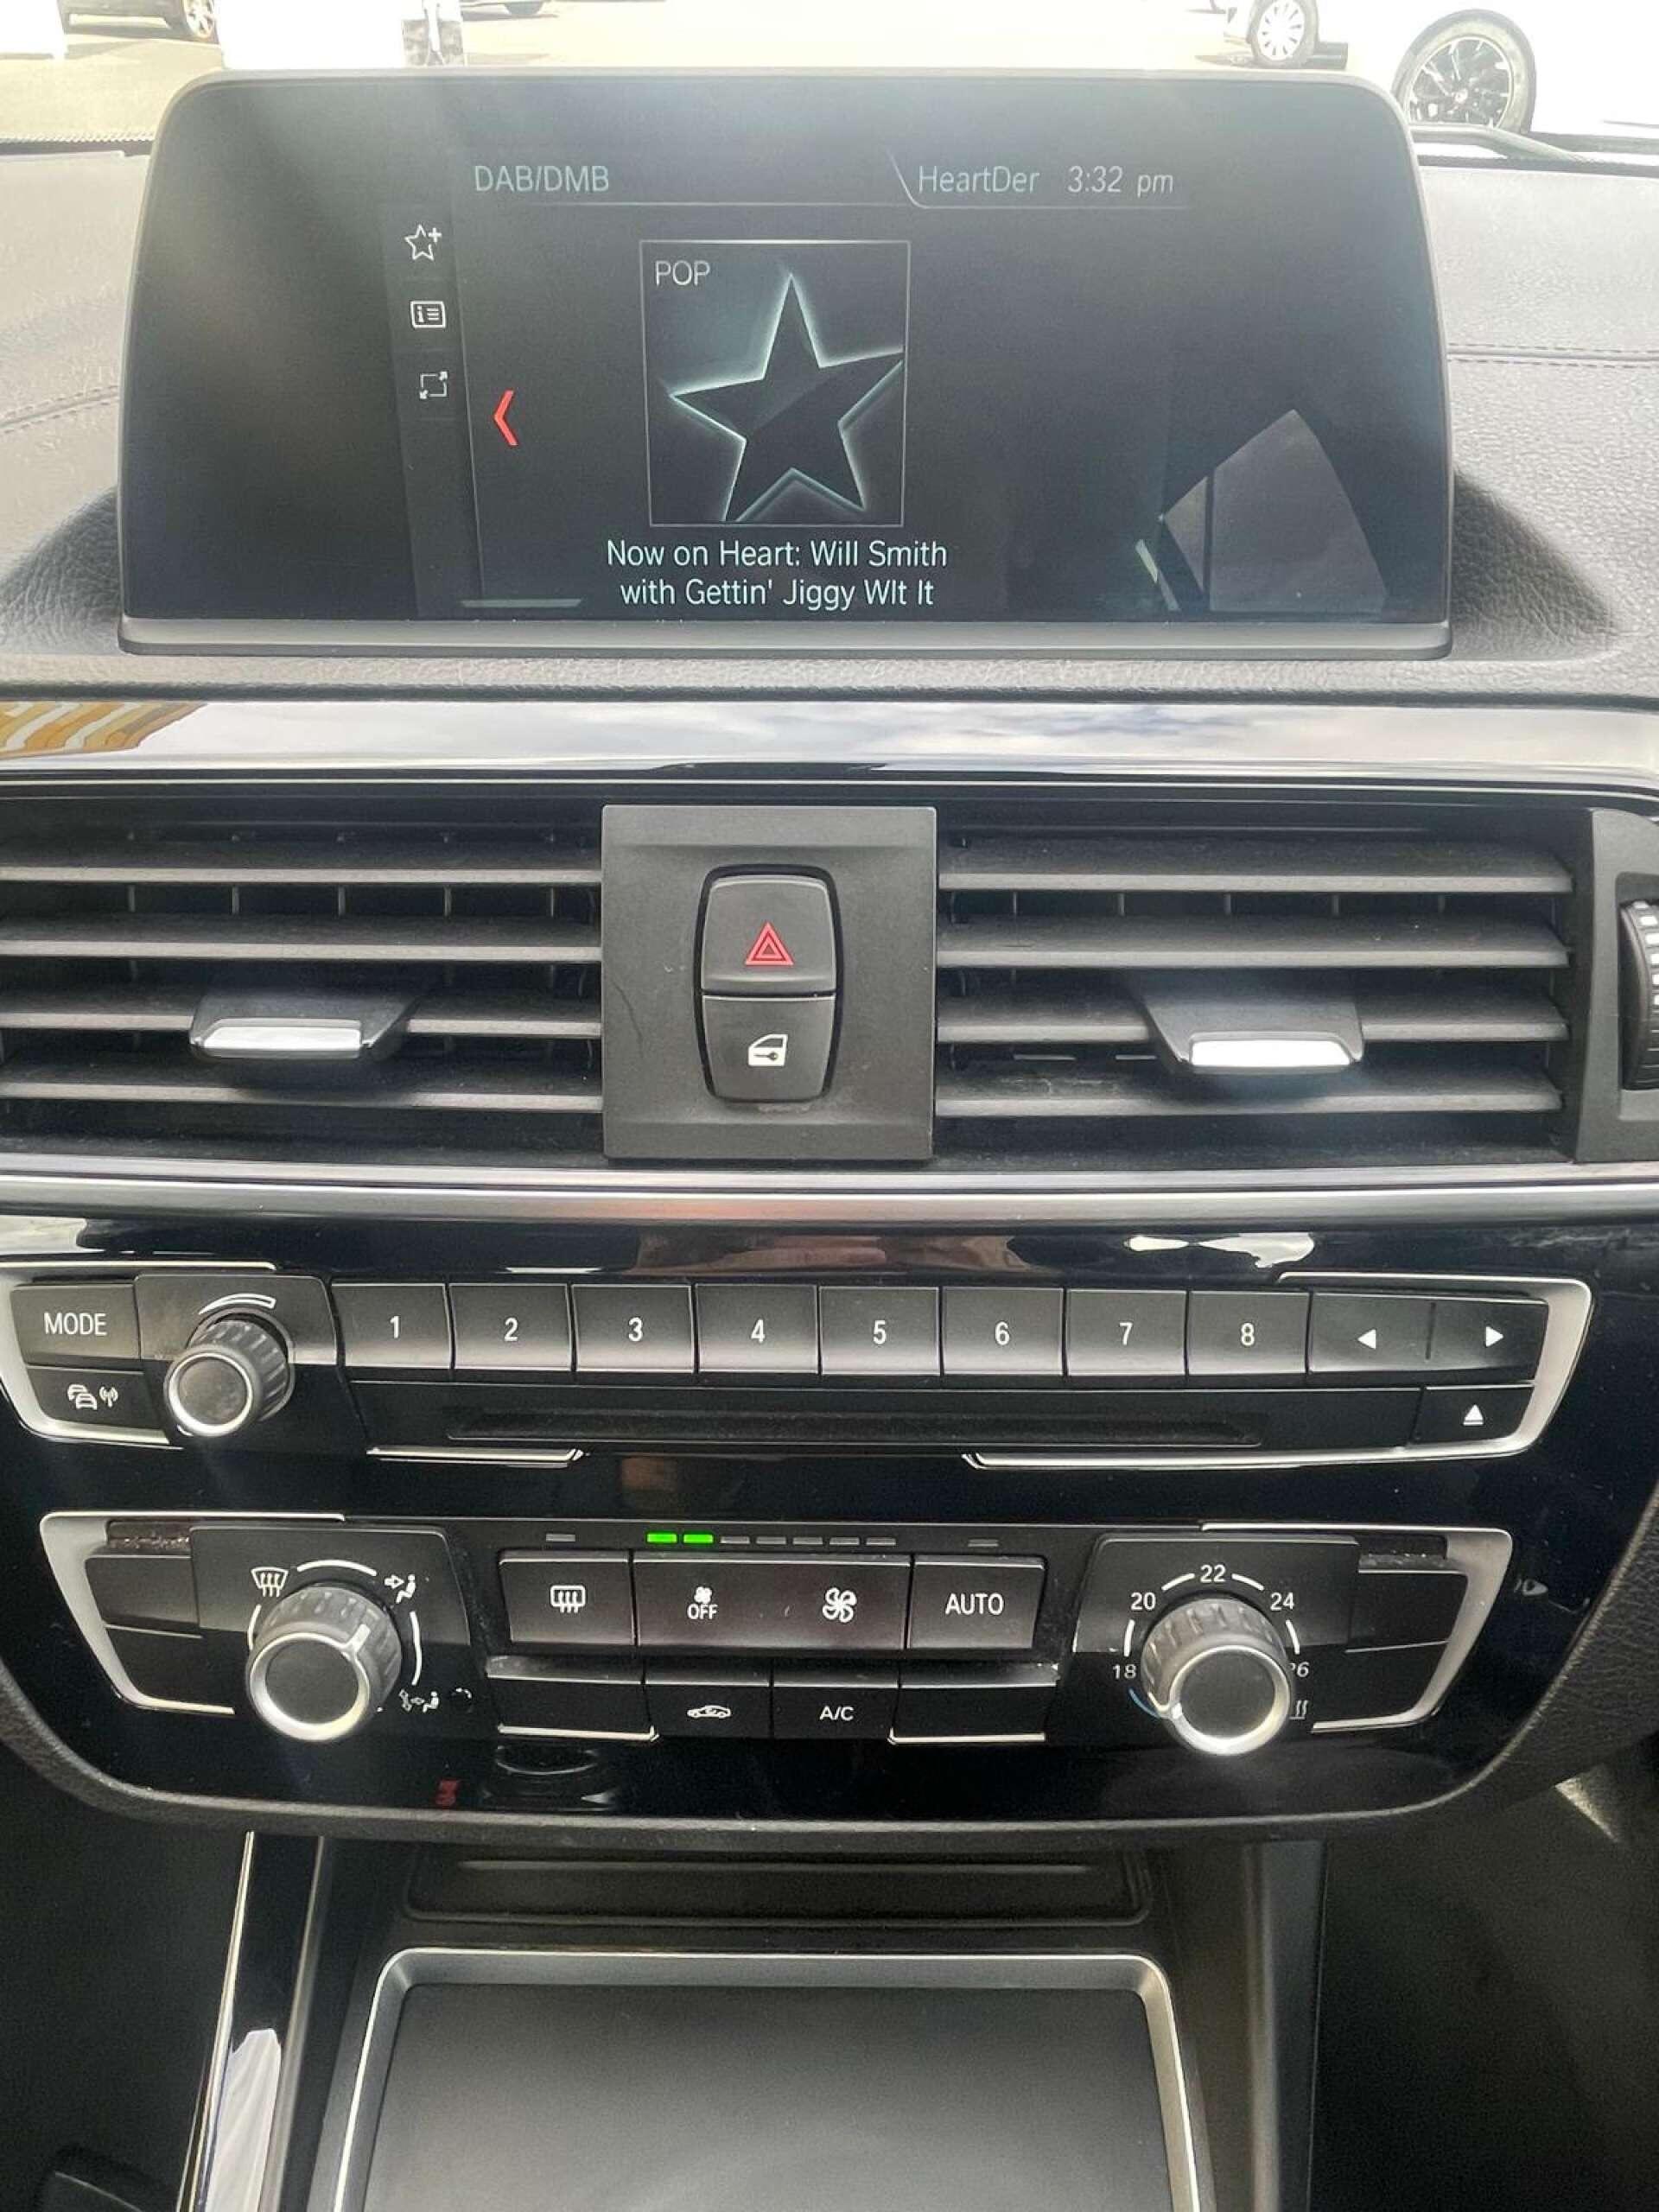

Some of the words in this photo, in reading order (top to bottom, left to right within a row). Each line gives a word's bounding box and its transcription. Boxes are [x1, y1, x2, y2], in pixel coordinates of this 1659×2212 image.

[474, 165, 610, 193] DAB/DMB
[918, 165, 1040, 193] HeartDer
[1068, 165, 1124, 193] 3:32
[1137, 175, 1174, 199] pm
[655, 259, 711, 286] POP
[607, 539, 664, 567] Now
[674, 544, 709, 567] on
[720, 540, 801, 567] Heart:
[810, 540, 858, 567] Will
[868, 540, 948, 567] Smith
[620, 578, 677, 605] with
[685, 578, 773, 606] Gettin'
[783, 579, 856, 612] Jiggy
[918, 579, 935, 605] It
[43, 1312, 108, 1337] MODE
[390, 1315, 400, 1338] 1
[504, 1317, 518, 1342] 2
[628, 1317, 643, 1342] 3
[751, 1319, 766, 1344] 4
[873, 1319, 887, 1344] 5
[995, 1320, 1010, 1346] 6
[1119, 1321, 1134, 1345] 7
[1241, 1322, 1255, 1347] 8
[1199, 1564, 1227, 1583] 22
[687, 1604, 718, 1620] OFF
[944, 1592, 1004, 1617] AUTO
[1130, 1592, 1157, 1611] 20
[1269, 1592, 1295, 1611] 24
[1112, 1663, 1137, 1680] 18
[819, 1705, 855, 1721] A/C
